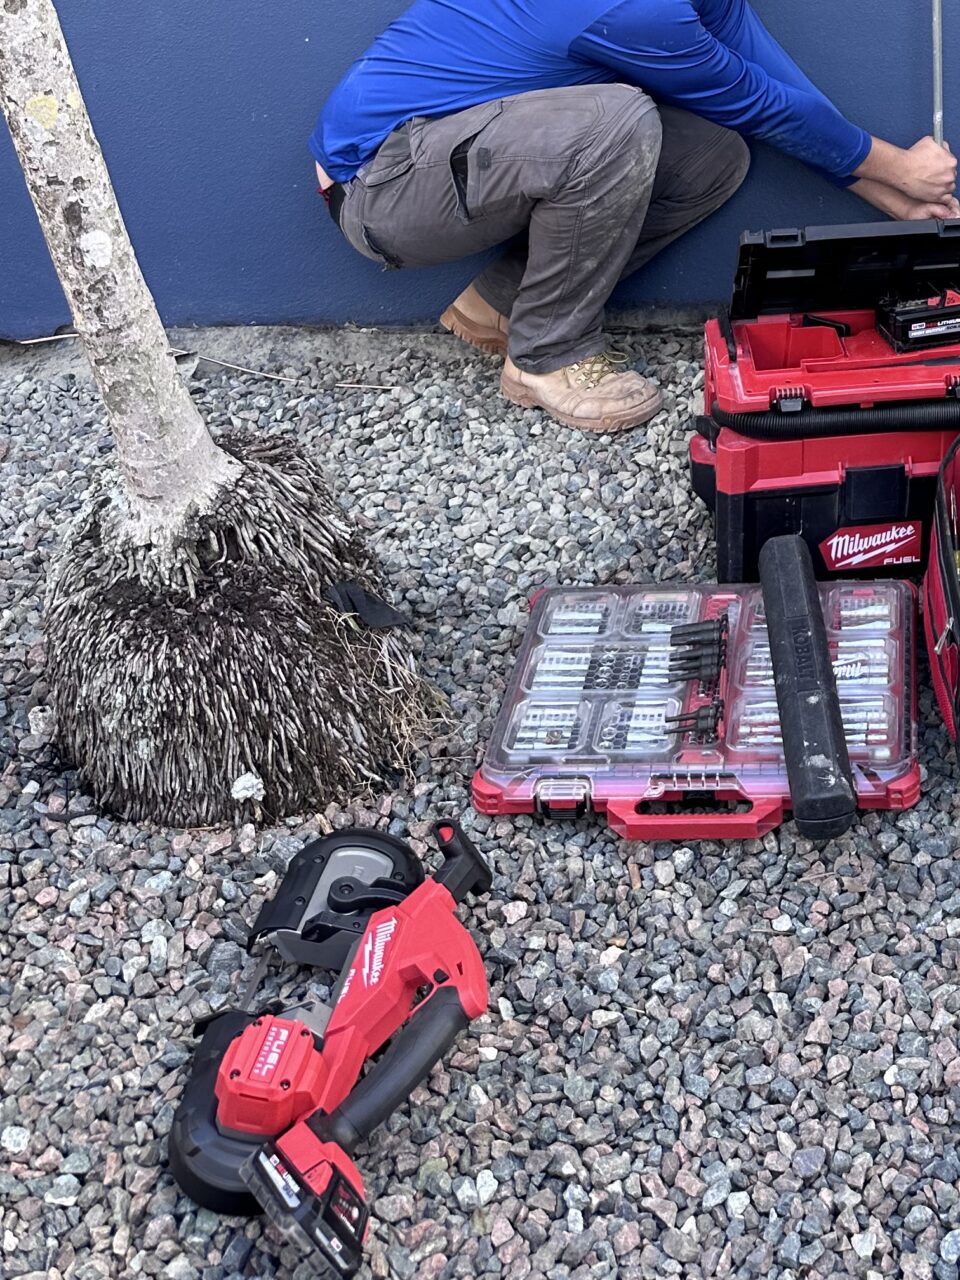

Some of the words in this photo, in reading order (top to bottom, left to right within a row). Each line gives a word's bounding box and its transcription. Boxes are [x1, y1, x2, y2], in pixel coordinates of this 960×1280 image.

[827, 525, 915, 561] Milwaukee
[883, 556, 921, 566] FUEL
[792, 628, 816, 679] KOBALT
[370, 916, 398, 986] Milwaukee
[261, 1028, 289, 1076] FUEL
